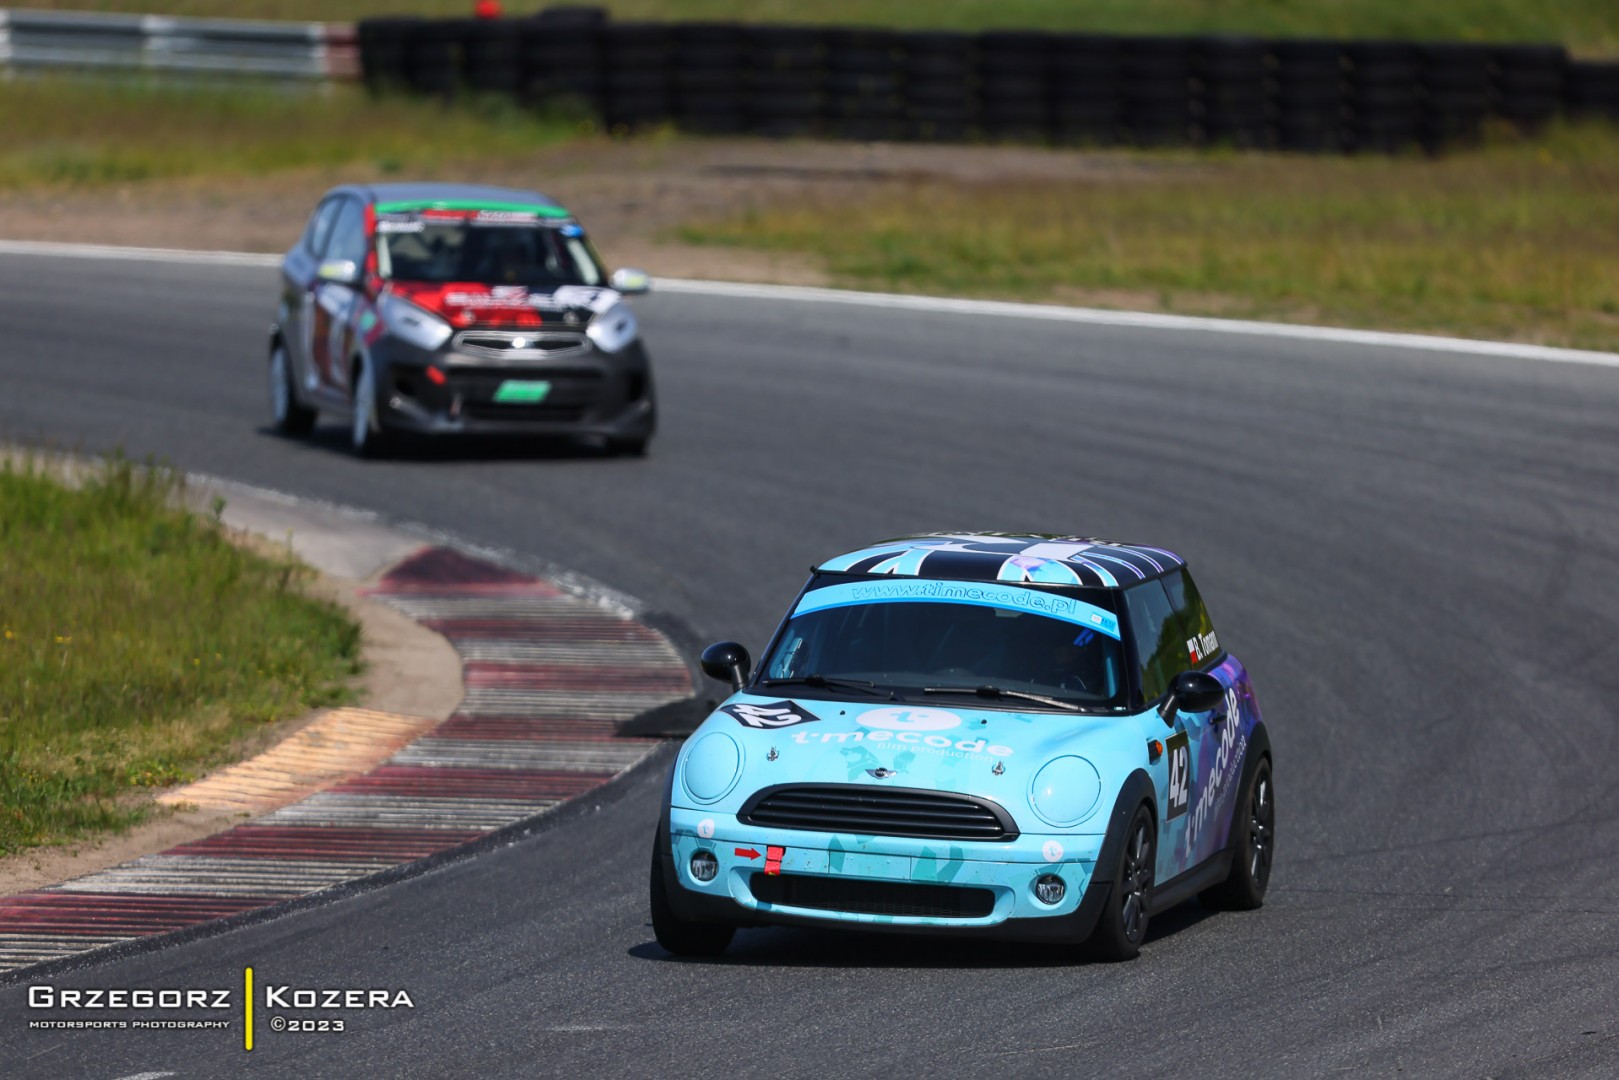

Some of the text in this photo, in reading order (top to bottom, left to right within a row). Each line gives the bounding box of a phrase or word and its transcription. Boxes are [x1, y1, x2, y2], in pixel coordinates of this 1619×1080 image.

[852, 581, 1077, 614] www.timecode.pl
[910, 745, 994, 763] production
[1169, 746, 1188, 808] 42
